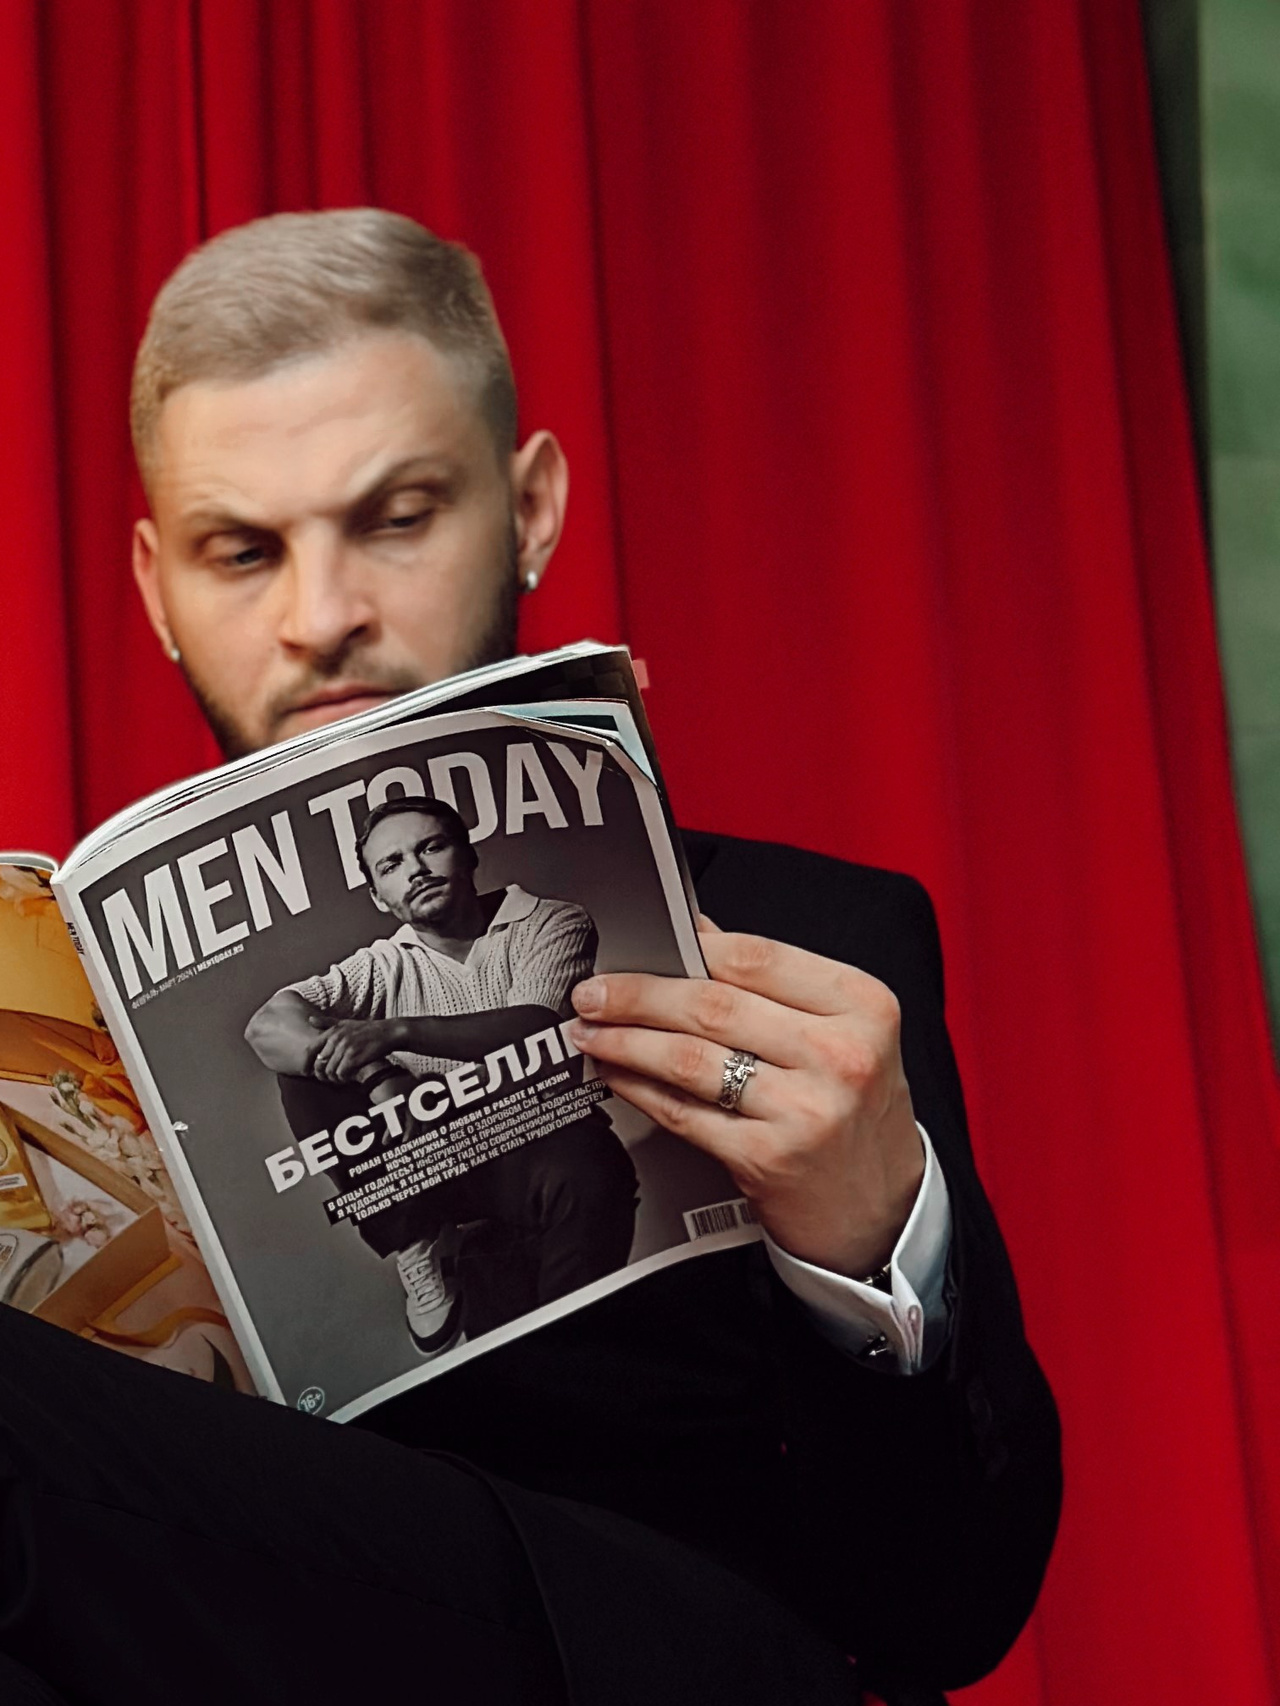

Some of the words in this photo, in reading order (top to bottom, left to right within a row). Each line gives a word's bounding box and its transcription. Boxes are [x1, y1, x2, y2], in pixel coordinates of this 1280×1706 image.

[101, 810, 311, 1000] MEN
[327, 1201, 336, 1212] В
[336, 1187, 364, 1207] ОТЦЫ
[364, 1163, 415, 1194] ГОДИТЕСЬ?
[415, 1137, 472, 1169] ИНСТРУКЦИЯ
[471, 1133, 480, 1145] К
[478, 1105, 541, 1140] ПРАВИЛЬНОМУ
[336, 1208, 345, 1219] Я
[344, 1183, 400, 1215] ХУДОЖНИК.
[399, 1178, 408, 1189] Я
[407, 1169, 426, 1184] ТАК
[457, 1147, 478, 1165] ГИД
[475, 1140, 490, 1156] ПО
[488, 1110, 559, 1150] СОВРЕМЕННОМУ
[348, 1155, 382, 1178] РОМАН
[382, 1129, 439, 1162] ЕВДОКИМОВ
[439, 1125, 448, 1135] О
[448, 1109, 483, 1132] ЛЮБВИ
[483, 1105, 492, 1116] В
[492, 1089, 527, 1112] РАБОТЕ
[527, 1085, 536, 1095] И
[535, 1070, 571, 1092] ЖИЗНИ
[354, 1197, 392, 1221] ТОЛЬКО
[391, 1184, 421, 1202] ЧЕРЕЗ
[420, 1172, 442, 1190] МОЙ
[441, 1162, 470, 1180] ТРУД:
[469, 1152, 488, 1168] КАК
[487, 1147, 500, 1159] НЕ
[499, 1136, 526, 1153] СТАТЬ
[525, 1106, 592, 1142] ТРУДОГОЛИКОМ
[385, 1155, 412, 1172] НОЧЬ
[411, 1137, 449, 1160] НУЖНА:
[466, 1124, 475, 1134] О
[474, 1103, 522, 1131] ЗДОРОВОМ
[522, 1095, 540, 1109] СНЕ
[300, 1393, 322, 1412] 16+
